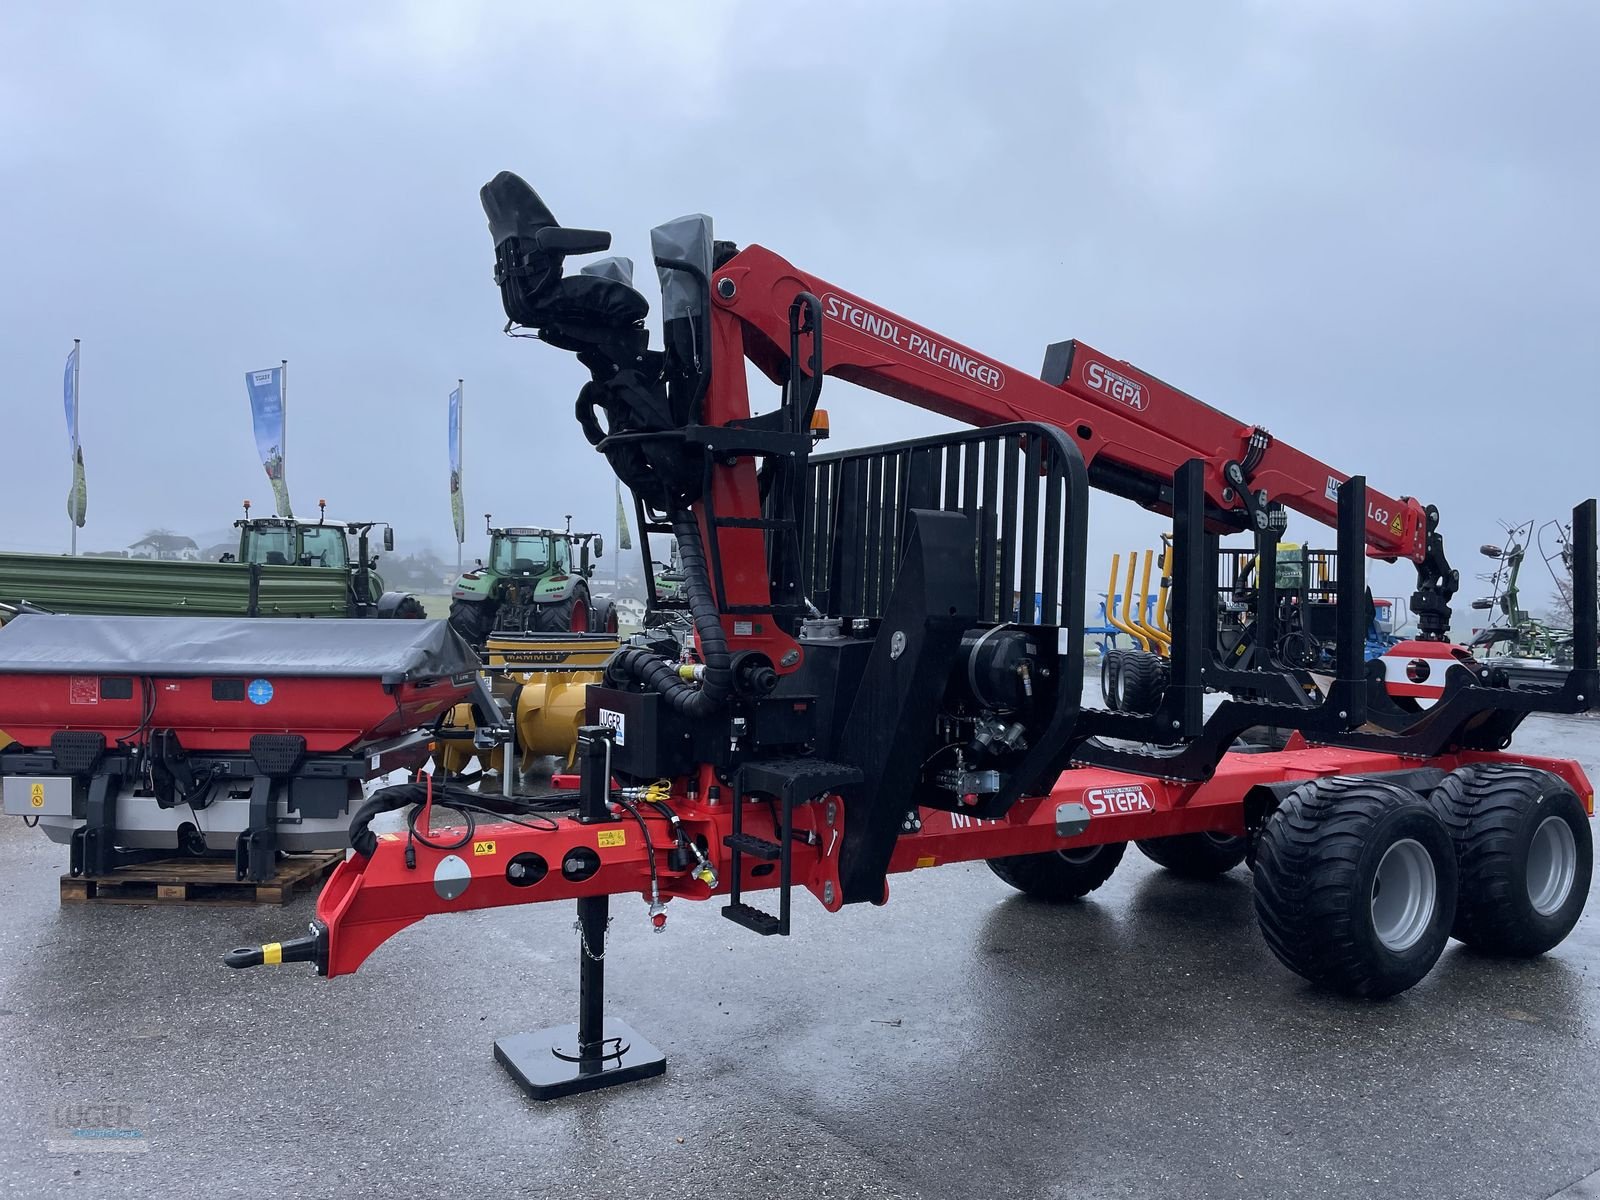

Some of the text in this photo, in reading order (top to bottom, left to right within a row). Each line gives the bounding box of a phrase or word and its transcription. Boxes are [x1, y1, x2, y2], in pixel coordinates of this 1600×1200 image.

[826, 297, 1000, 388] STEINDL-PALFINGER
[1087, 363, 1142, 410] STEPA
[1367, 501, 1389, 526] L62
[600, 711, 621, 730] LUGER
[1088, 790, 1151, 815] STEPA
